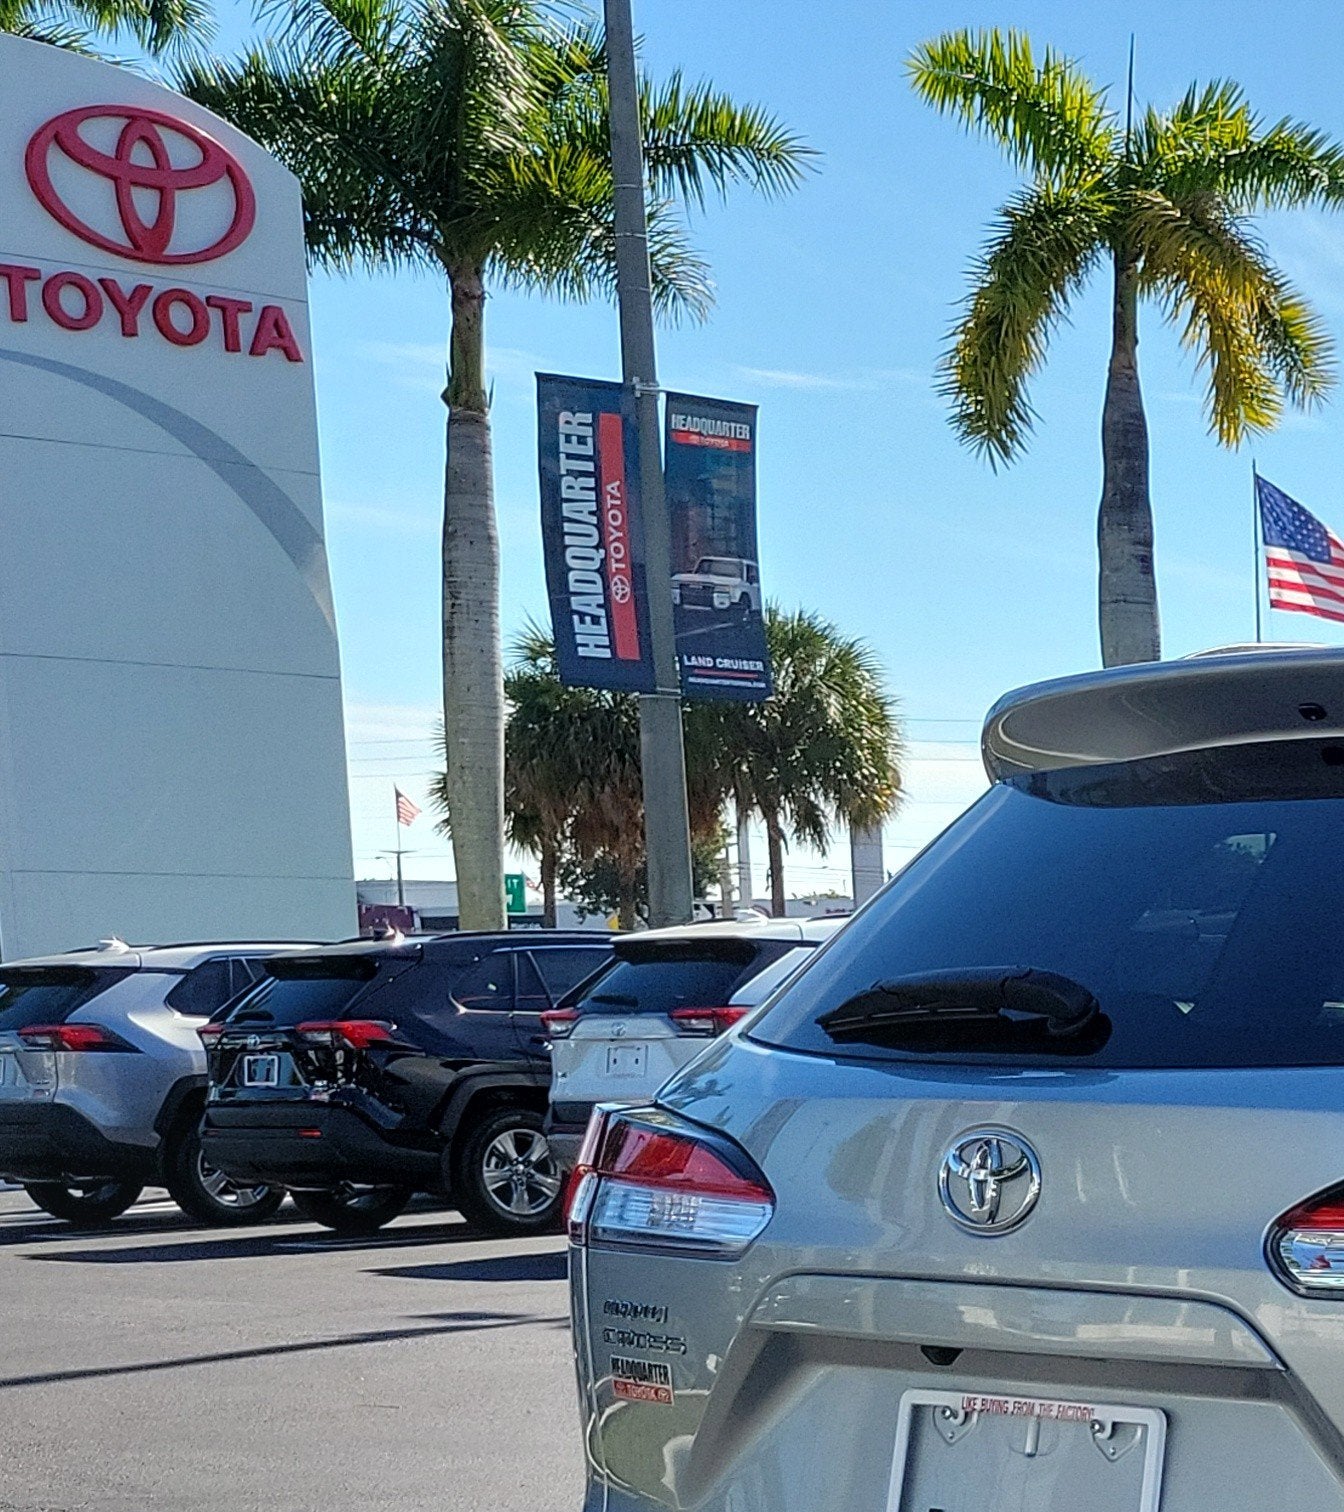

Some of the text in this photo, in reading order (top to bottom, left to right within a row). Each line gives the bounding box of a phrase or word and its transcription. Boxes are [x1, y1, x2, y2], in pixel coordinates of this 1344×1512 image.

[0, 263, 304, 363] TOYOTA
[671, 413, 750, 440] HEADQUARTER
[559, 411, 611, 659] HEADQUARTER
[606, 480, 626, 572] TOYOTA
[683, 654, 764, 672] LAND CRUISER
[961, 1396, 978, 1412] LIKE
[980, 1398, 1010, 1415] BUYING
[1011, 1400, 1036, 1417] FROM
[1037, 1402, 1055, 1420] THE
